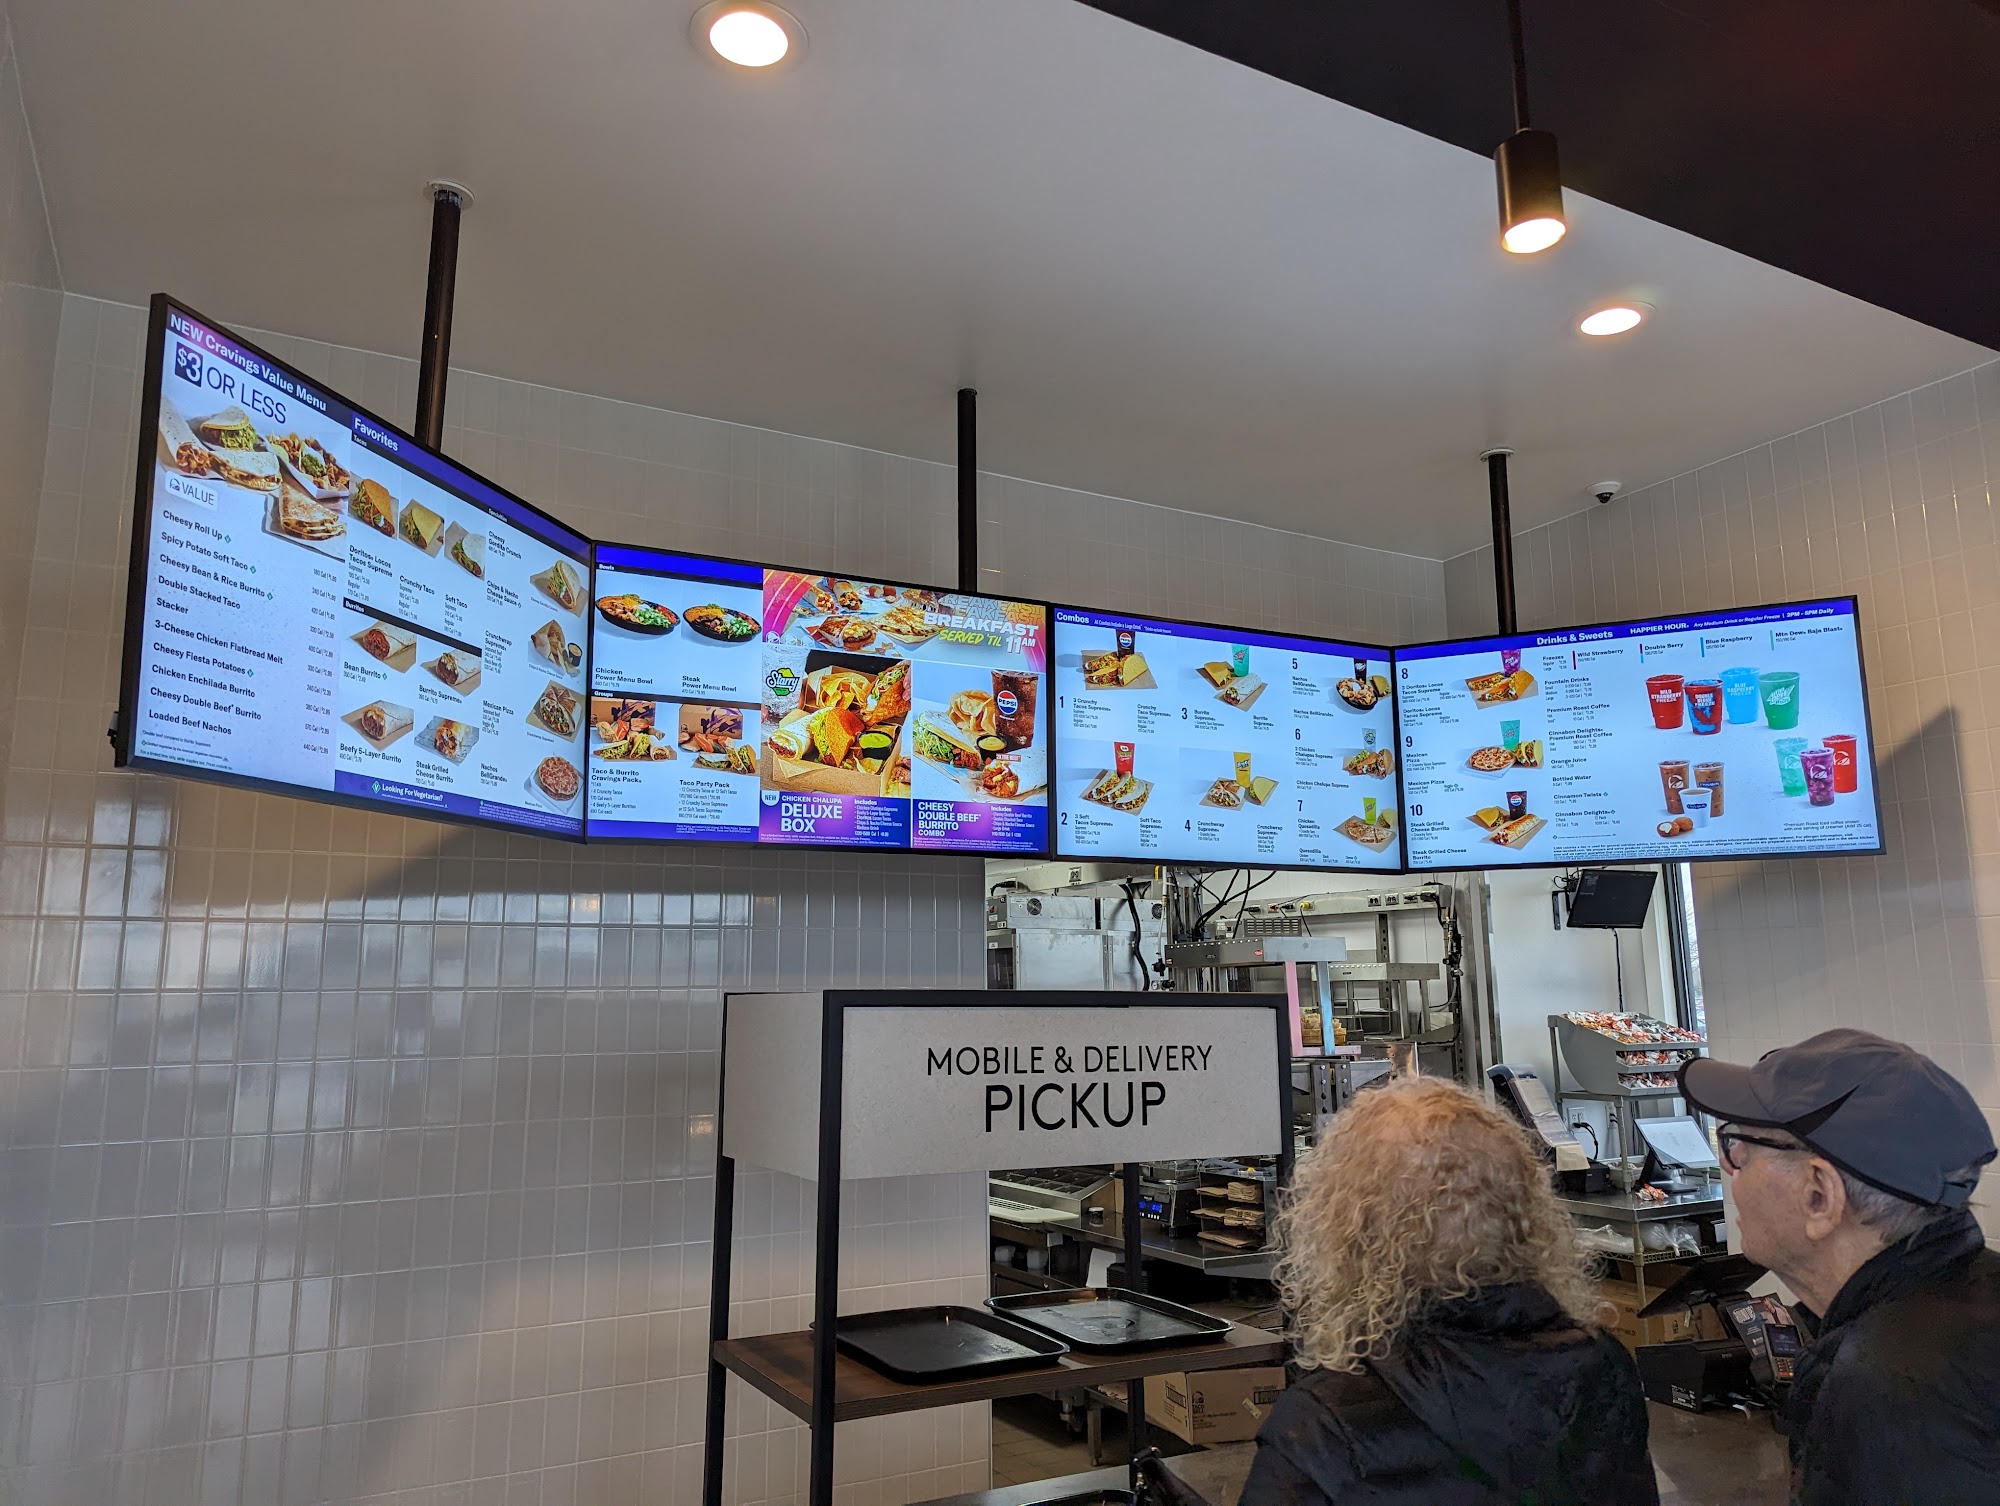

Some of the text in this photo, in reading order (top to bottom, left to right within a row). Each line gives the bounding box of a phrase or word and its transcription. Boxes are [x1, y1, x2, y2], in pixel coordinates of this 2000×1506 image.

[171, 314, 327, 411] NEW Cravings Value Menu
[177, 346, 286, 424] $3 OR LESS
[354, 417, 398, 452] Favorites
[354, 434, 367, 447] Tacos
[182, 482, 214, 505] VALUE
[163, 510, 222, 541] Cheesy Roll Up
[161, 532, 248, 571] Spicy Potato Soft Taco
[349, 554, 392, 577] Tacos Supreme
[375, 556, 391, 568] Locos
[160, 554, 265, 598] Cheesy Bean & Rice Burrito
[400, 576, 435, 594] Crunchy Taco
[159, 576, 240, 610] Double Stacked Taco
[156, 597, 188, 614] Stacker
[346, 601, 364, 612] Burritos
[446, 594, 467, 608] Soft Taco
[924, 612, 1038, 637] BREAKFAST
[1057, 612, 1089, 623] Combos
[940, 628, 984, 645] SERVED
[1630, 625, 1663, 634] HAPPIER
[155, 620, 283, 664] 3-Cheese Chicken Flatbread Melt
[1537, 636, 1567, 645] Drinks
[1579, 631, 1613, 640] Sweets
[1720, 635, 1752, 643] Raspberry
[154, 643, 246, 675] Cheesy Fiesta Potatoes
[1292, 658, 1297, 669] 5
[344, 662, 380, 679] Bean Burrito
[596, 667, 623, 676] Chicken
[1402, 668, 1408, 679] 8
[152, 664, 255, 697] Chicken Enchilada Burrito
[596, 674, 653, 685] Power Menu Bowl
[766, 671, 799, 692] Starry
[702, 683, 719, 691] Menu
[150, 687, 181, 705] Cheesy
[183, 694, 211, 709] Double
[236, 707, 261, 721] Burrito
[483, 700, 514, 715] Mexican Pizza
[997, 699, 1017, 708] PEPSI
[1059, 696, 1064, 708] 1
[1181, 708, 1188, 720] 3
[149, 709, 232, 735] Loaded Beef Nachos
[1295, 728, 1300, 740] 6
[1406, 736, 1412, 747] 9
[340, 744, 401, 763] Beefy 5-Layer Burrito
[416, 761, 448, 774] Steak Grilled
[416, 769, 453, 783] Cheese Burrito
[592, 775, 621, 783] Cravings
[382, 784, 443, 801] Looking For Vegetarian?
[781, 804, 842, 818] DELUXE
[918, 802, 954, 810] CHEESY
[1298, 800, 1302, 811] 7
[1410, 804, 1422, 816] 10
[918, 812, 955, 820] DOUBLE
[1061, 813, 1067, 825] 2
[781, 818, 815, 832] BOX
[918, 820, 959, 830] BURRITO
[1185, 820, 1191, 831] 4
[928, 1045, 1213, 1075] MOBILE & DELIVERY
[986, 1081, 1166, 1132] PICKUP
